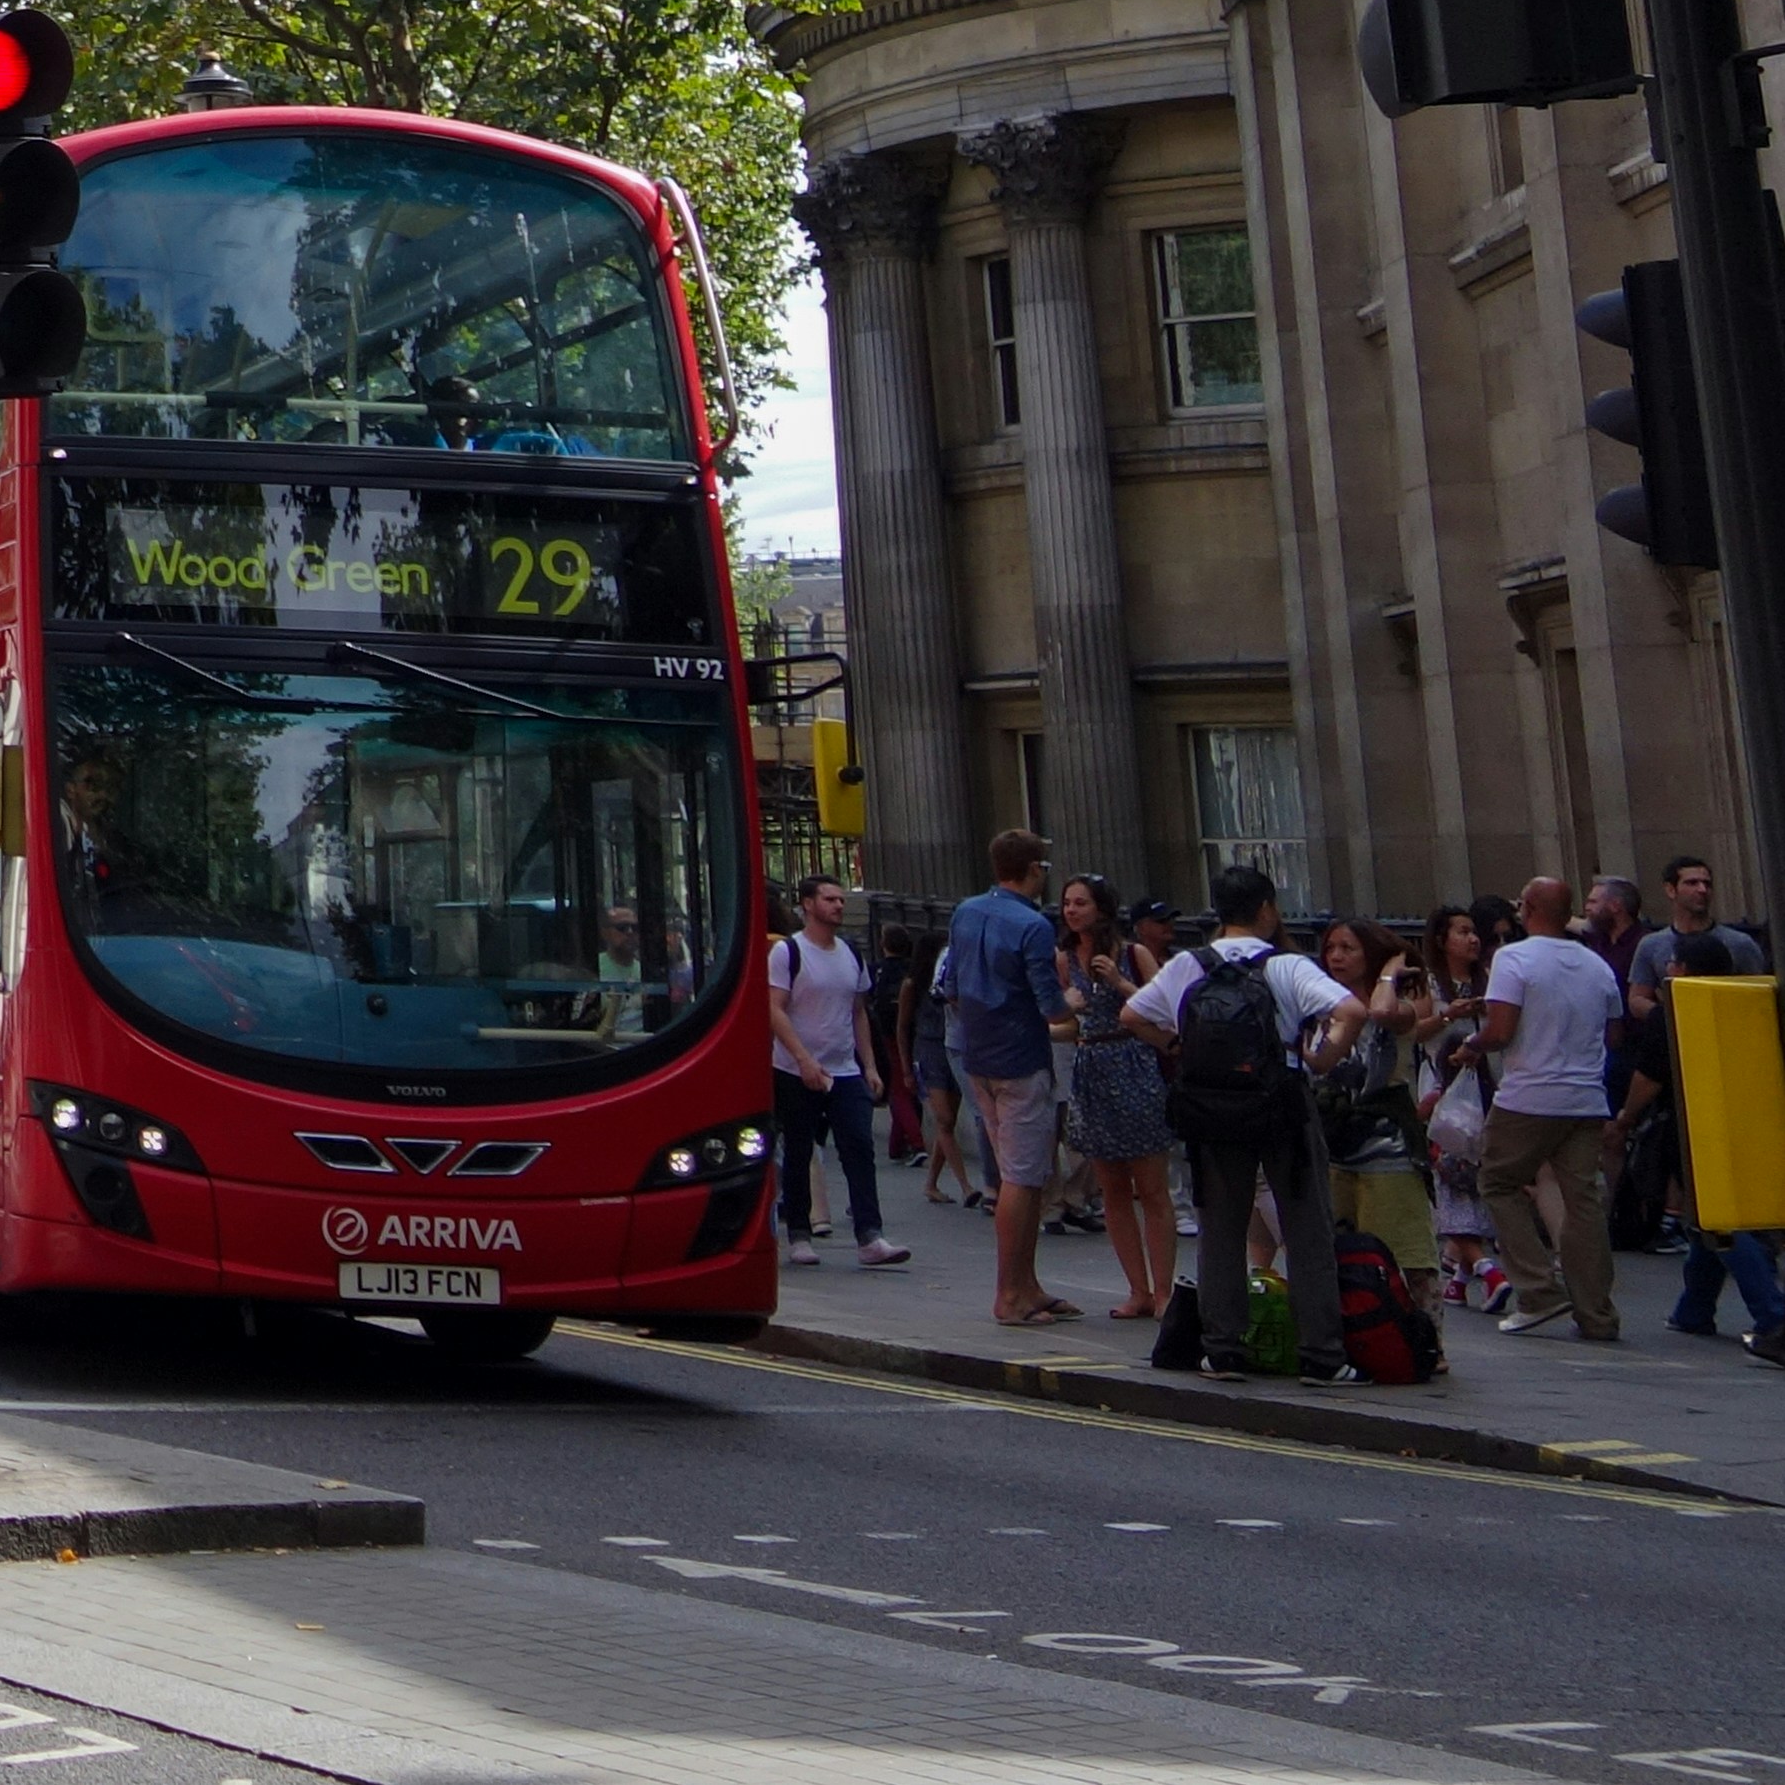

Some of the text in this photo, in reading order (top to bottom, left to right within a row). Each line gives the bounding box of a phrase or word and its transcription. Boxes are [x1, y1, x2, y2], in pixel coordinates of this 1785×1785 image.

[126, 537, 591, 615] Wood Green 29
[653, 656, 725, 681] HV 92
[386, 1085, 447, 1098] VOLVO
[377, 1215, 523, 1252] ARRIVA
[357, 1267, 482, 1298] LJ13 FCN
[886, 1610, 1443, 1705] LOOK
